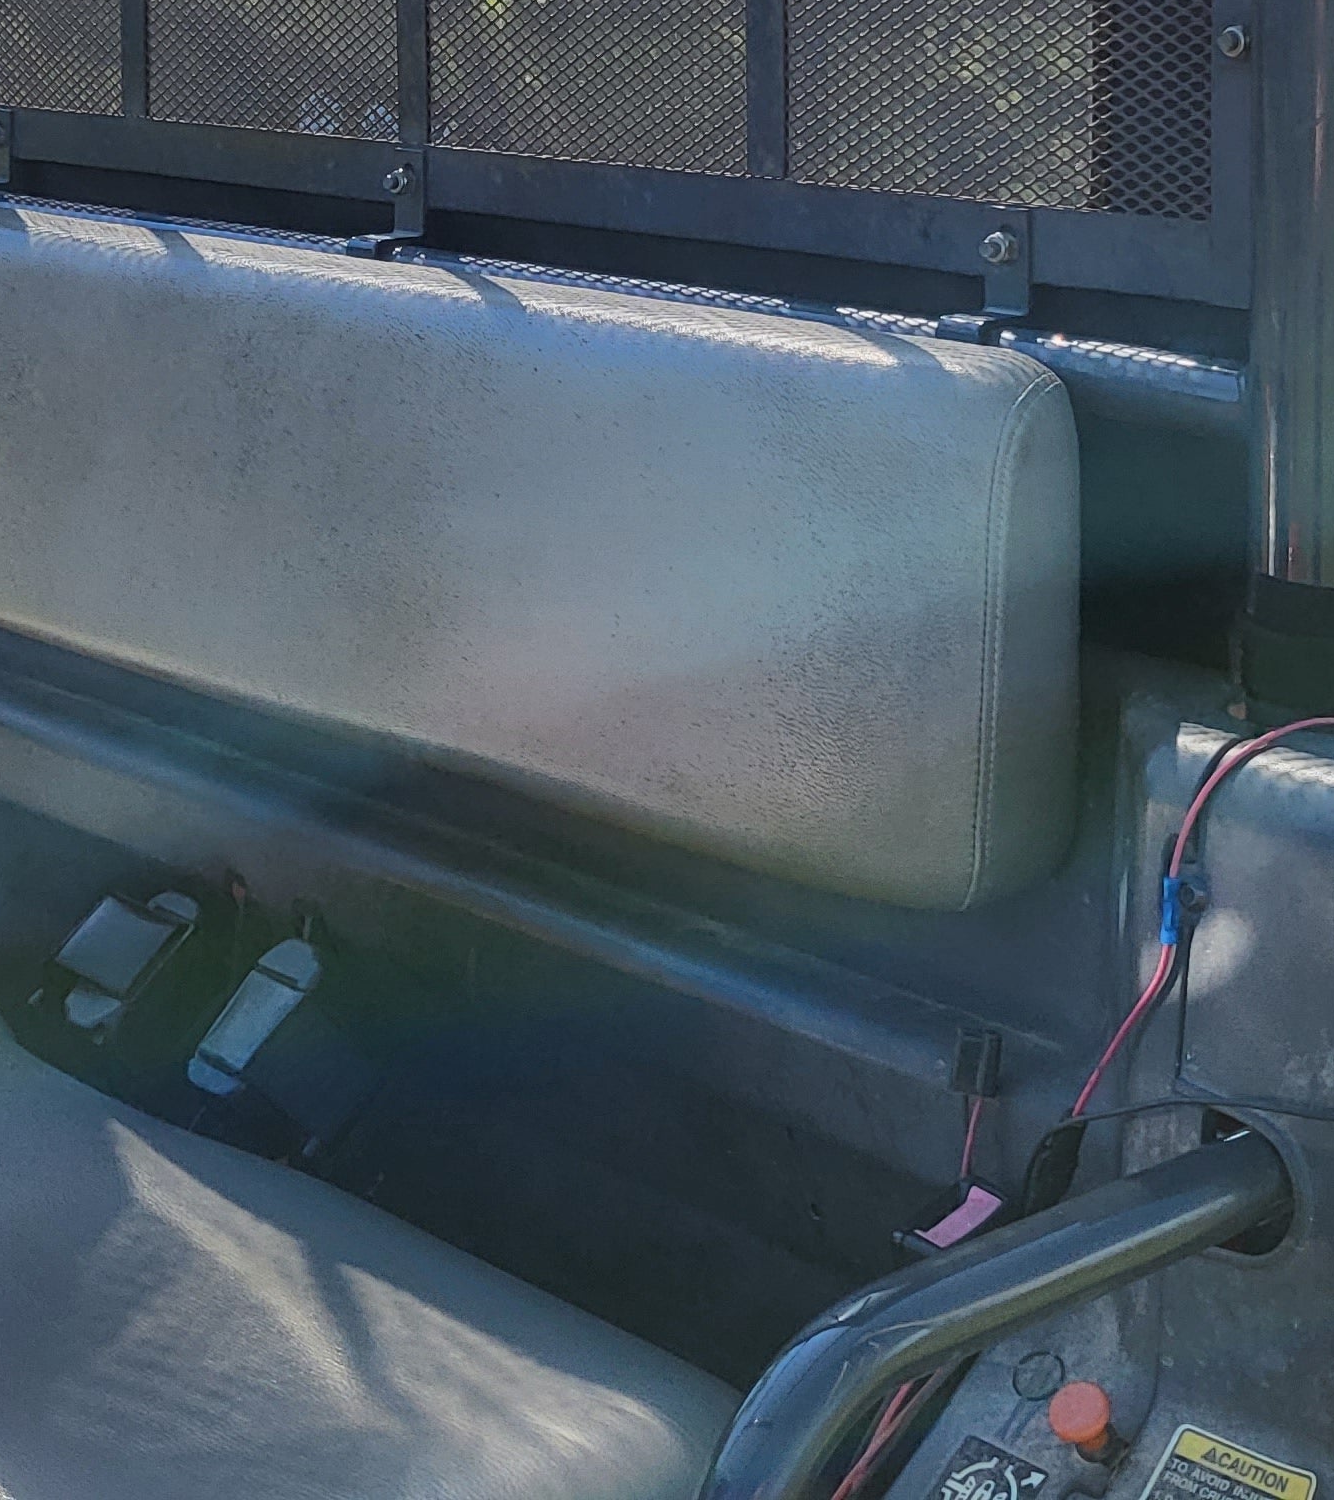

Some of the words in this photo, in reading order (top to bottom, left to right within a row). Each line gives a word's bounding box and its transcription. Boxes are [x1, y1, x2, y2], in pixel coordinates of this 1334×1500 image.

[1162, 1471, 1199, 1493] FROM
[1171, 1458, 1188, 1473] TO
[1191, 1469, 1230, 1491] AVOID
[1218, 1452, 1289, 1493] CAUTION
